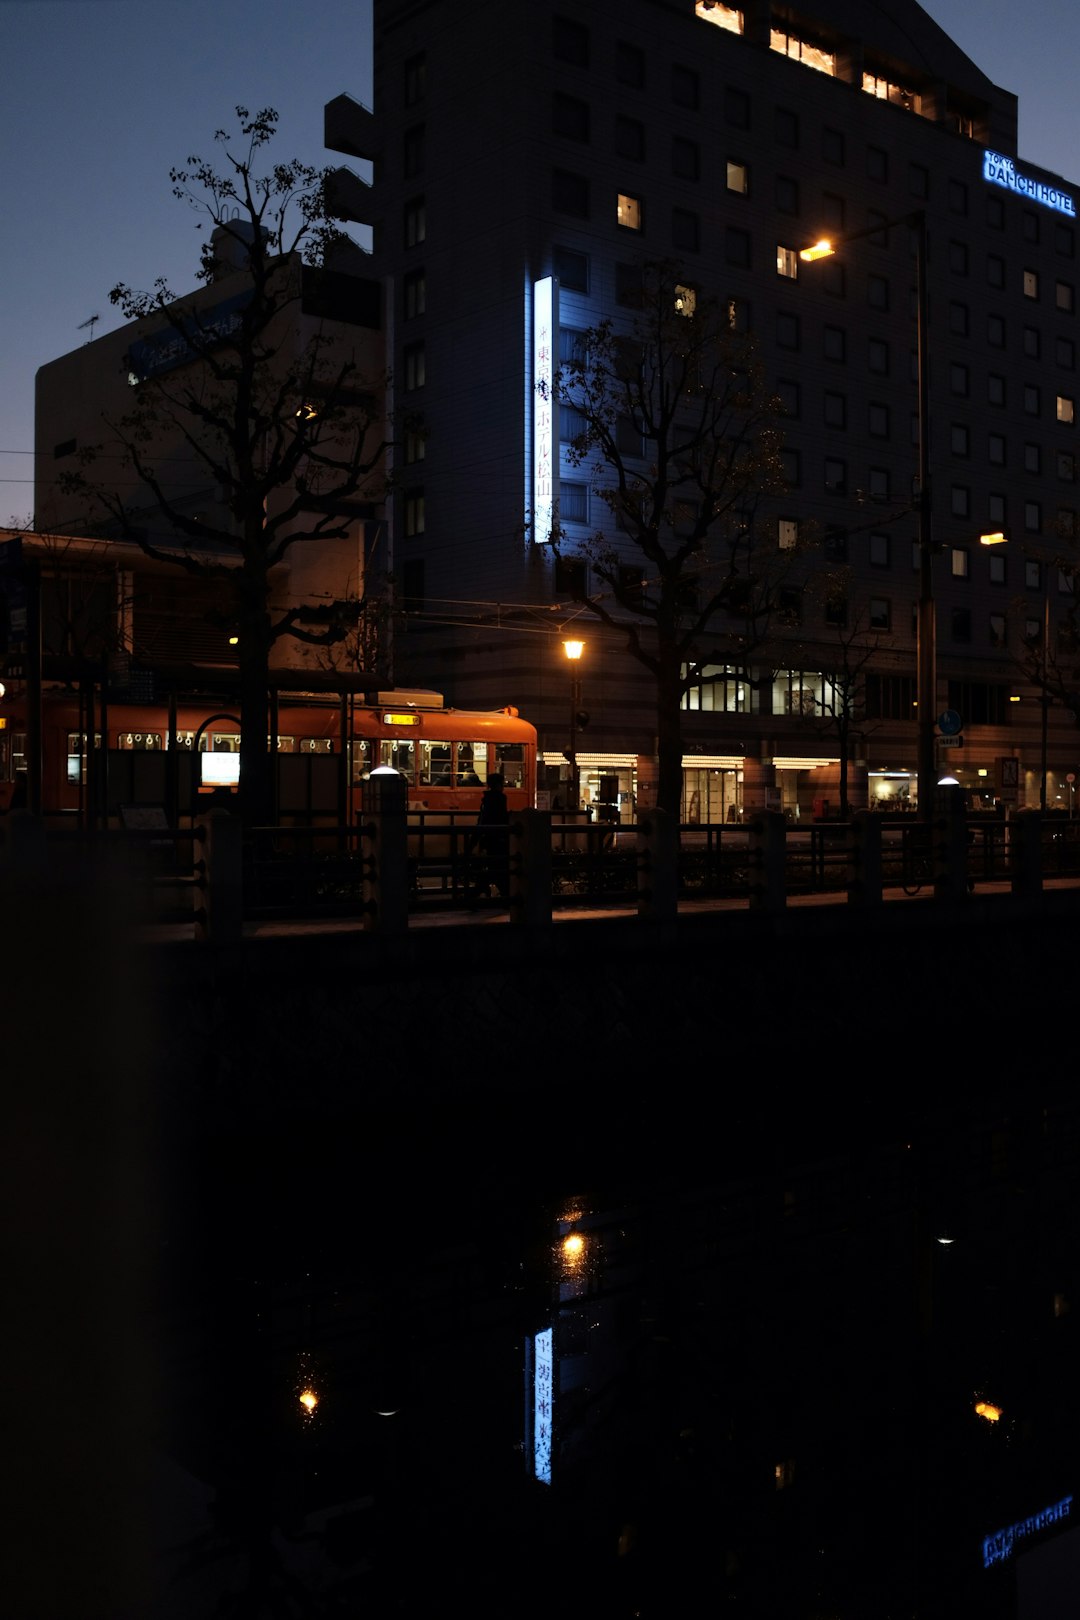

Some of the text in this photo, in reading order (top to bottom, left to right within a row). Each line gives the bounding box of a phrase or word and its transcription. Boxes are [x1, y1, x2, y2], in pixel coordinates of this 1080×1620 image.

[989, 152, 1015, 171] TOKYO
[989, 164, 1076, 214] DAI-ICHI HOTEL
